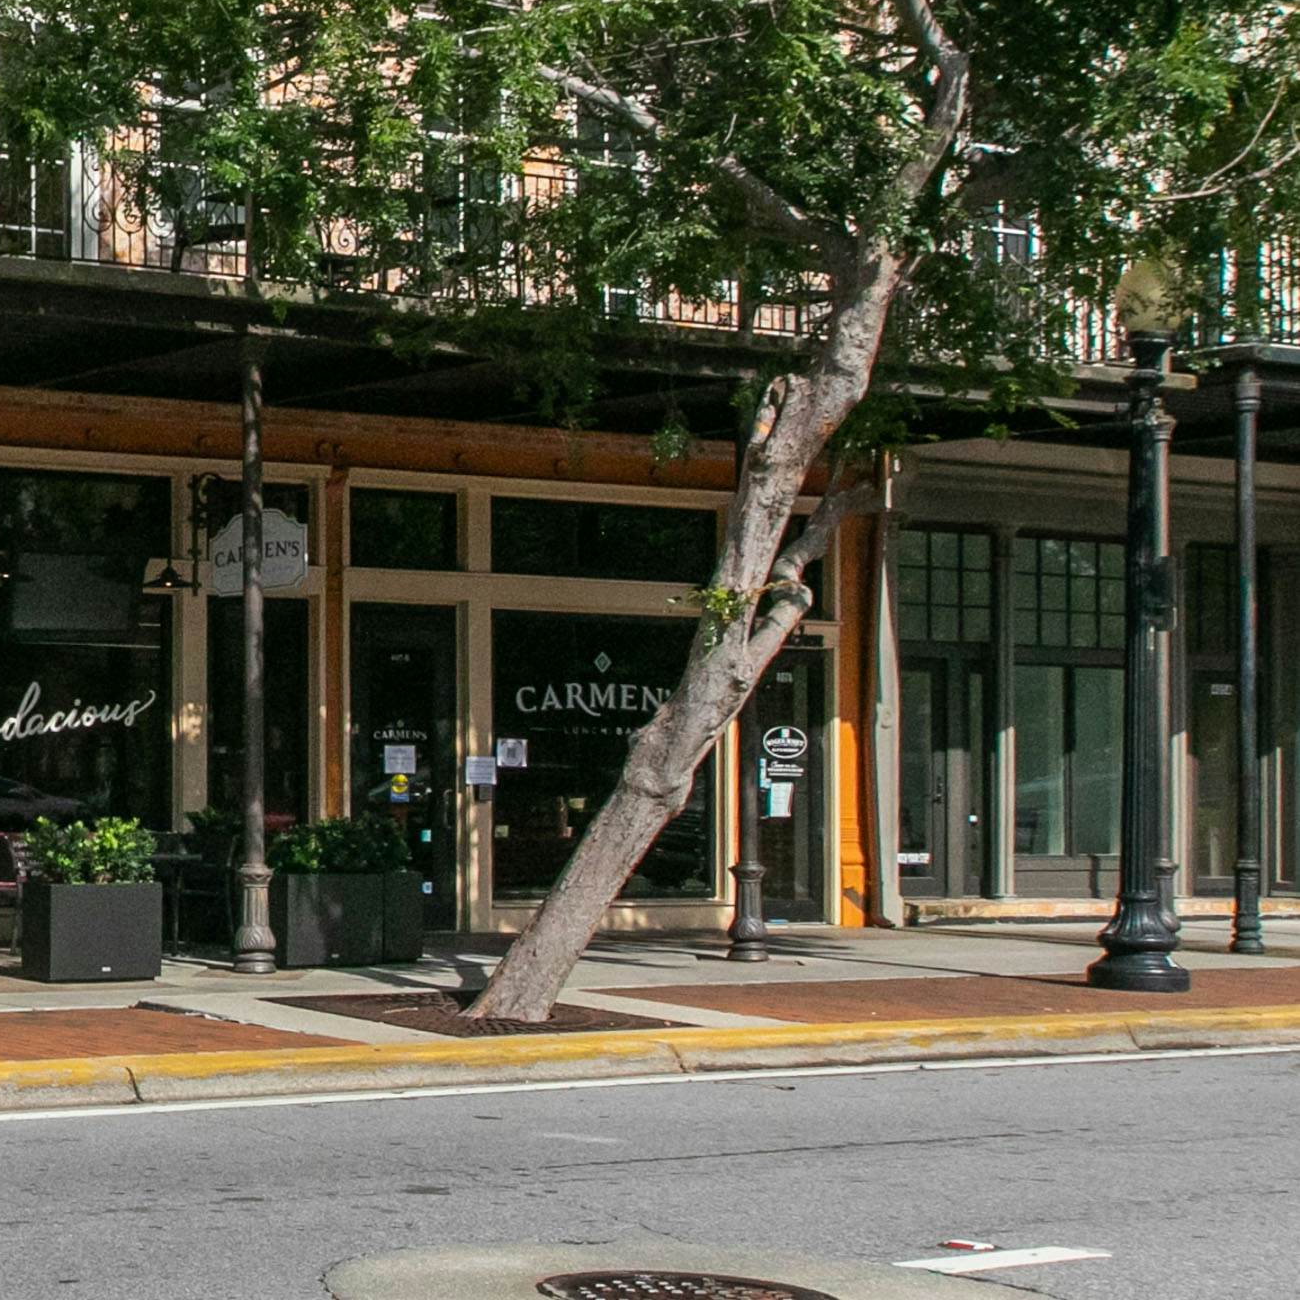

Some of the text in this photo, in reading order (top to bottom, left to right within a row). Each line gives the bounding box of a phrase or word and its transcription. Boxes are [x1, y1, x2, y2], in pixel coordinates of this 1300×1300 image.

[215, 541, 300, 568] CAEN'S
[515, 682, 671, 717] CARMEN'
[615, 726, 637, 736] BA
